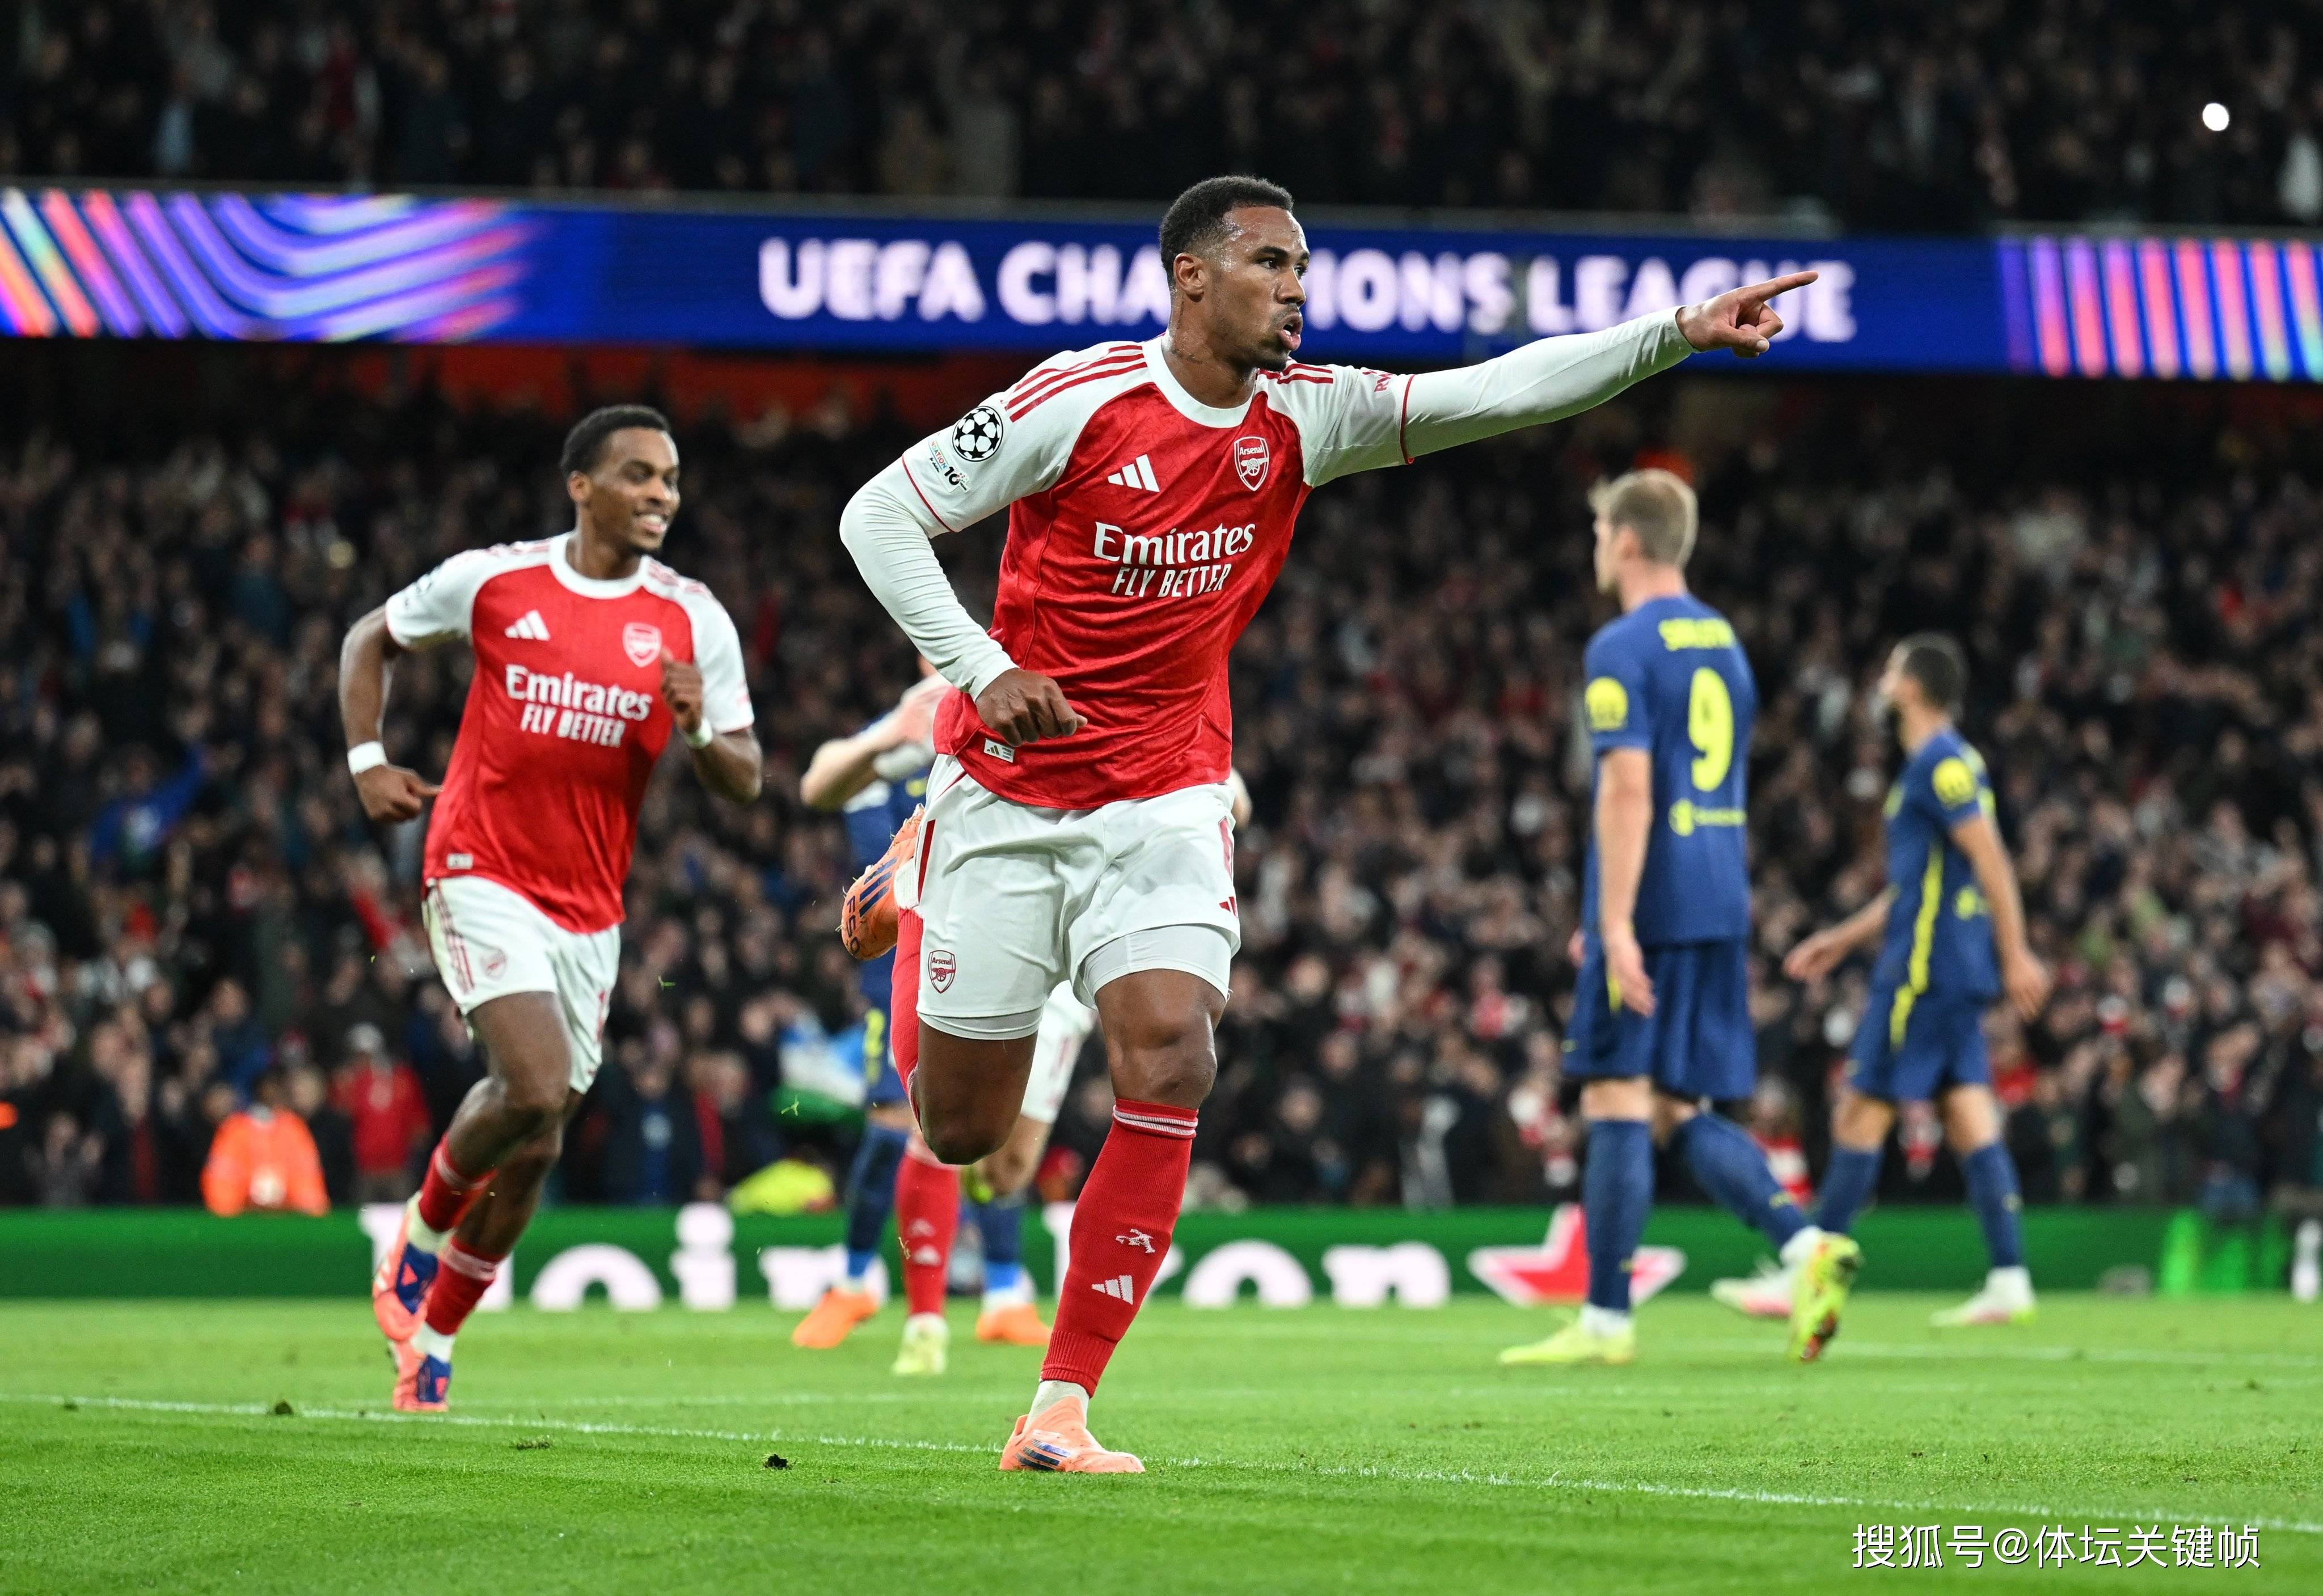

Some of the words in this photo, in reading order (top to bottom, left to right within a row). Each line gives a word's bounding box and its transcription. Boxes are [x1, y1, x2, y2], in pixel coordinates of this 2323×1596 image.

[758, 238, 986, 322] UEFA
[997, 241, 1515, 336] CHAIONS
[1239, 445, 1264, 456] Arsenal
[944, 466, 960, 485] 10
[1094, 522, 1256, 565] Emirates
[1111, 566, 1156, 598] FLY
[1158, 564, 1232, 598] BETTER
[505, 664, 653, 721] Emirates
[520, 702, 557, 735] FLY
[556, 710, 626, 748] BETTER
[1688, 666, 1733, 792] 9
